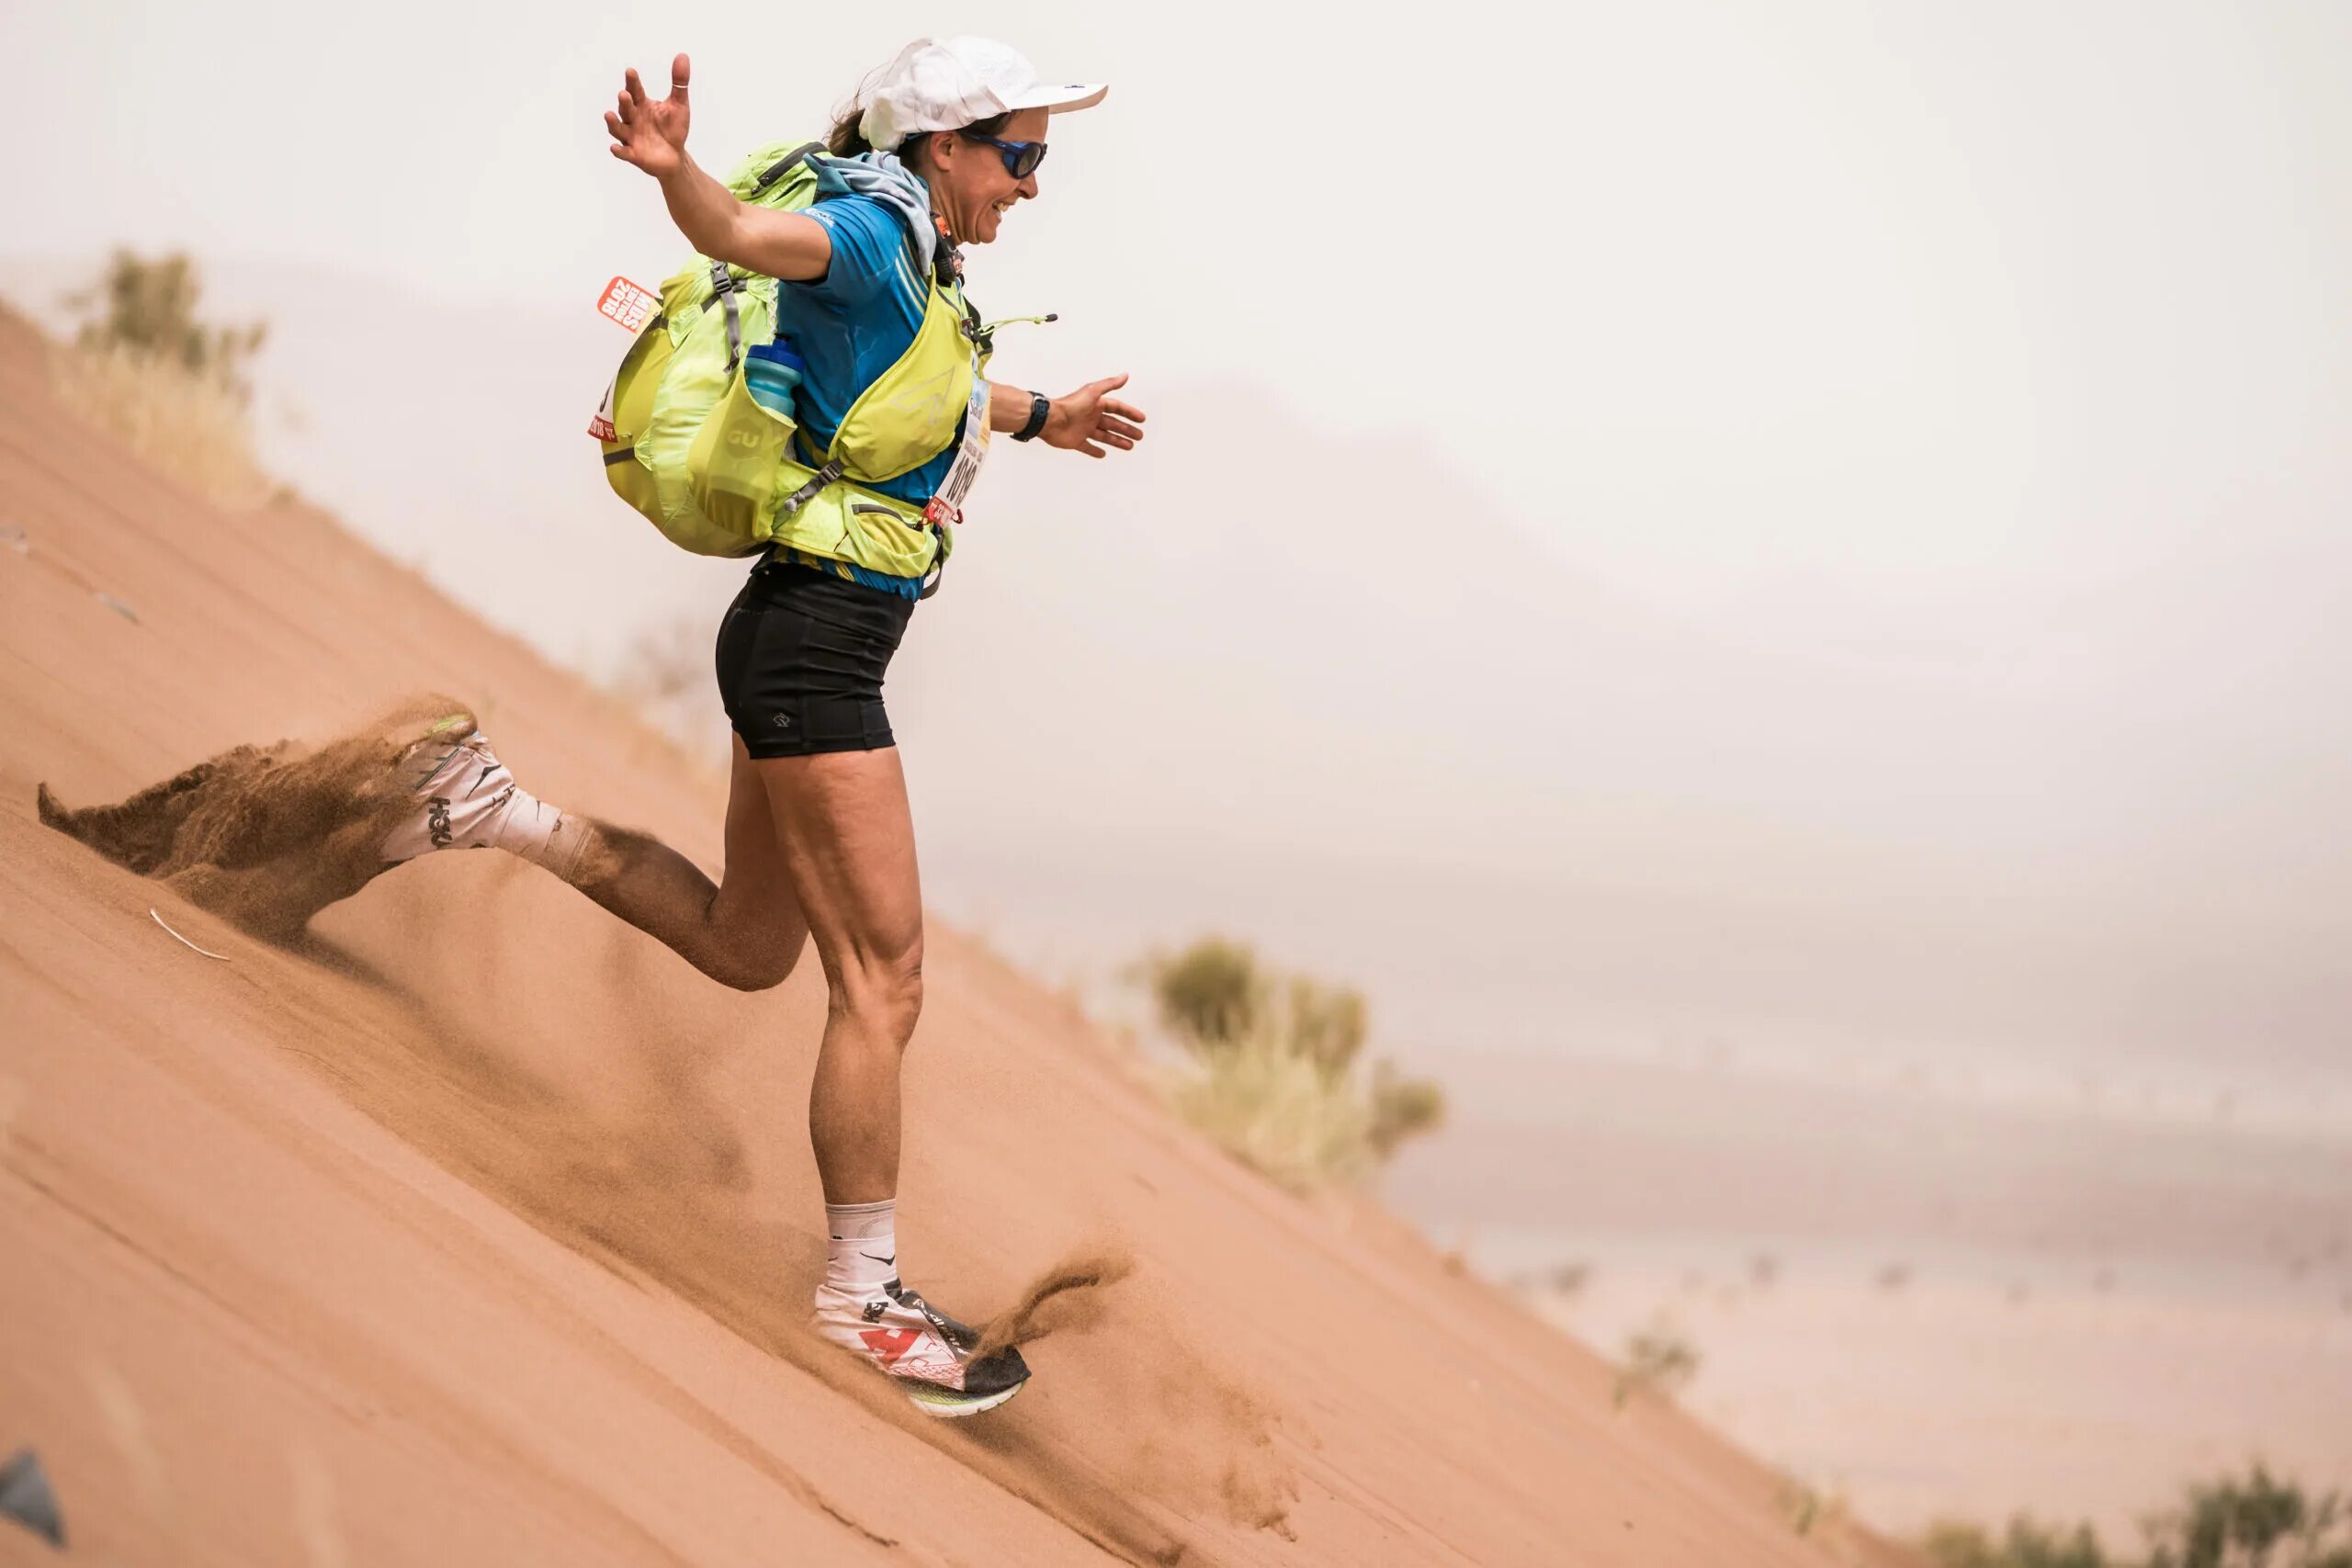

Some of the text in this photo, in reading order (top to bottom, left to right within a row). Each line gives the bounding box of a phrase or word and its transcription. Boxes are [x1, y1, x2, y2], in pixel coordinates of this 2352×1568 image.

[601, 278, 632, 317] 2018
[614, 286, 640, 322] EDITION
[622, 290, 653, 330] MDS
[727, 430, 759, 448] GU
